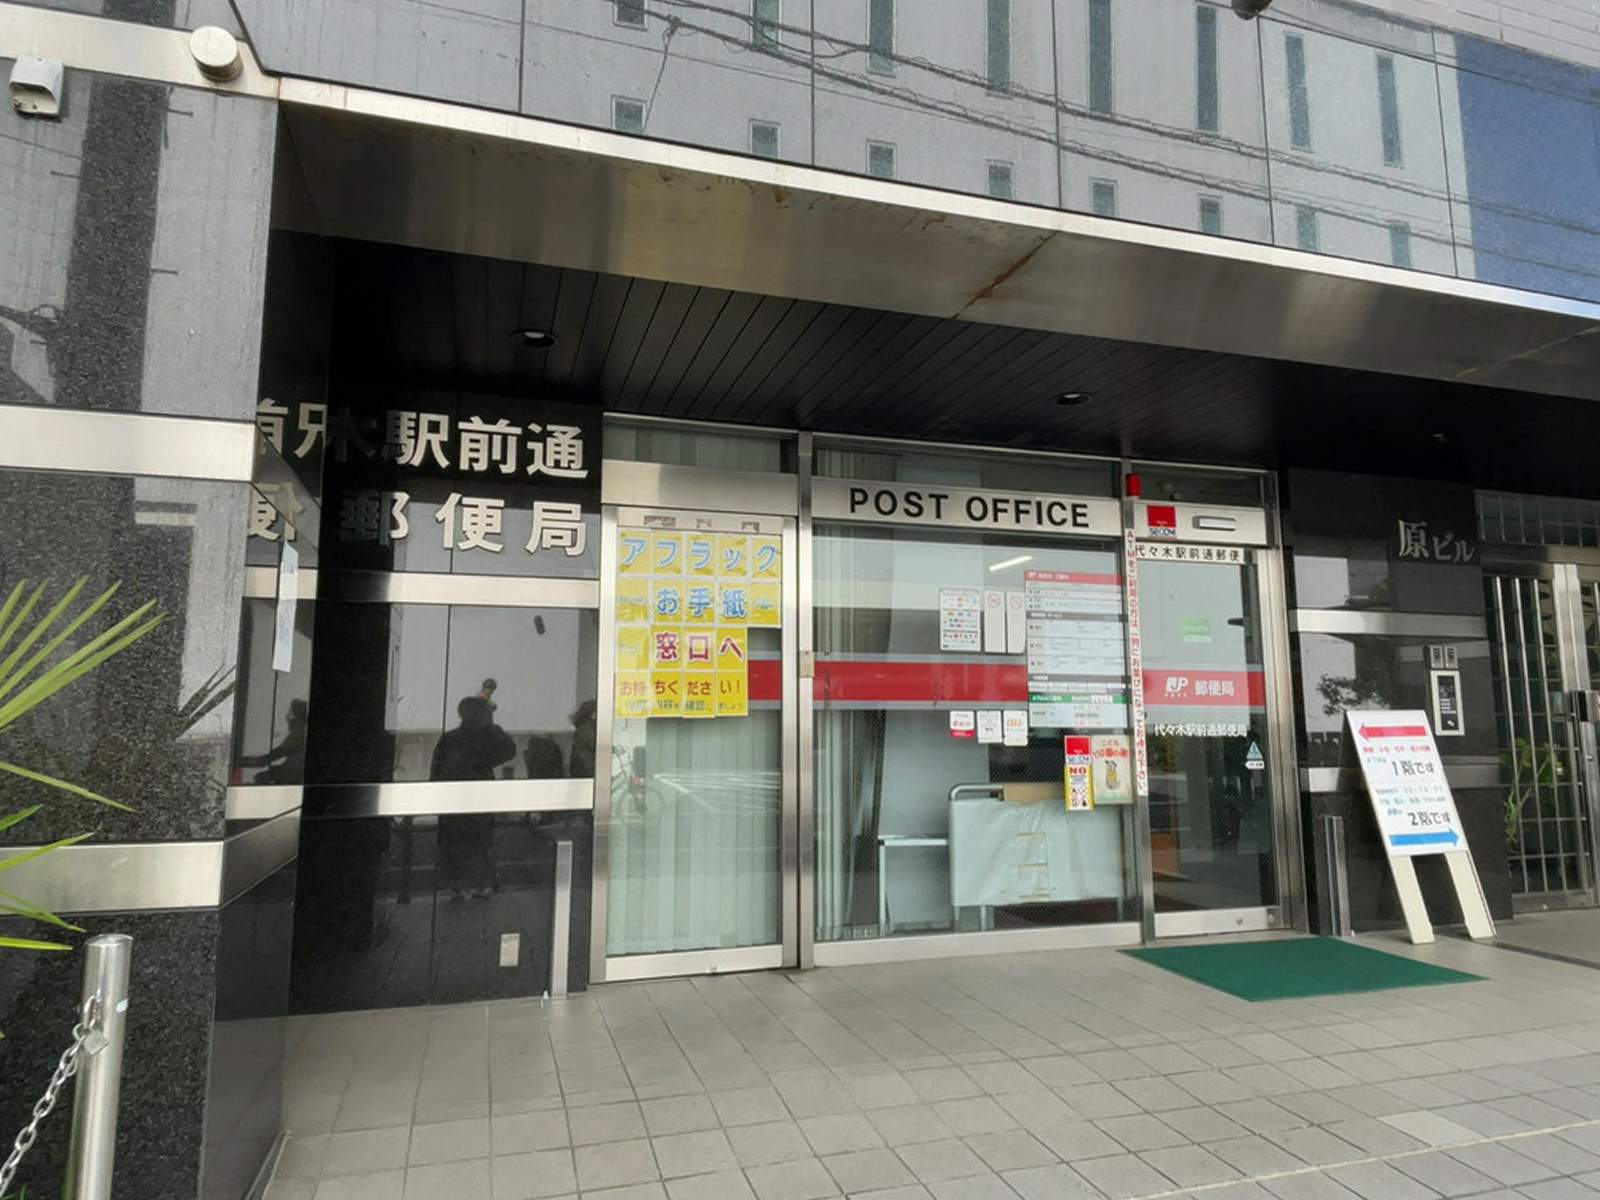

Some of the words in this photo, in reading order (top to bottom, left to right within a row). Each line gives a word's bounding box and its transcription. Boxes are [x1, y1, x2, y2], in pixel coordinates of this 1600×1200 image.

[850, 487, 948, 519] POST
[966, 496, 1089, 528] OFFICE
[339, 490, 587, 557] 郵便局
[622, 537, 777, 573] アフラック
[1398, 518, 1475, 563] 原ビル
[656, 587, 747, 618] お手紙
[655, 632, 744, 662] 窓口へ
[1194, 680, 1235, 697] 郵便局
[1154, 723, 1248, 738] 代々木駅前通郵便局
[1391, 760, 1435, 777] 1階です
[1408, 811, 1452, 827] 2階です
